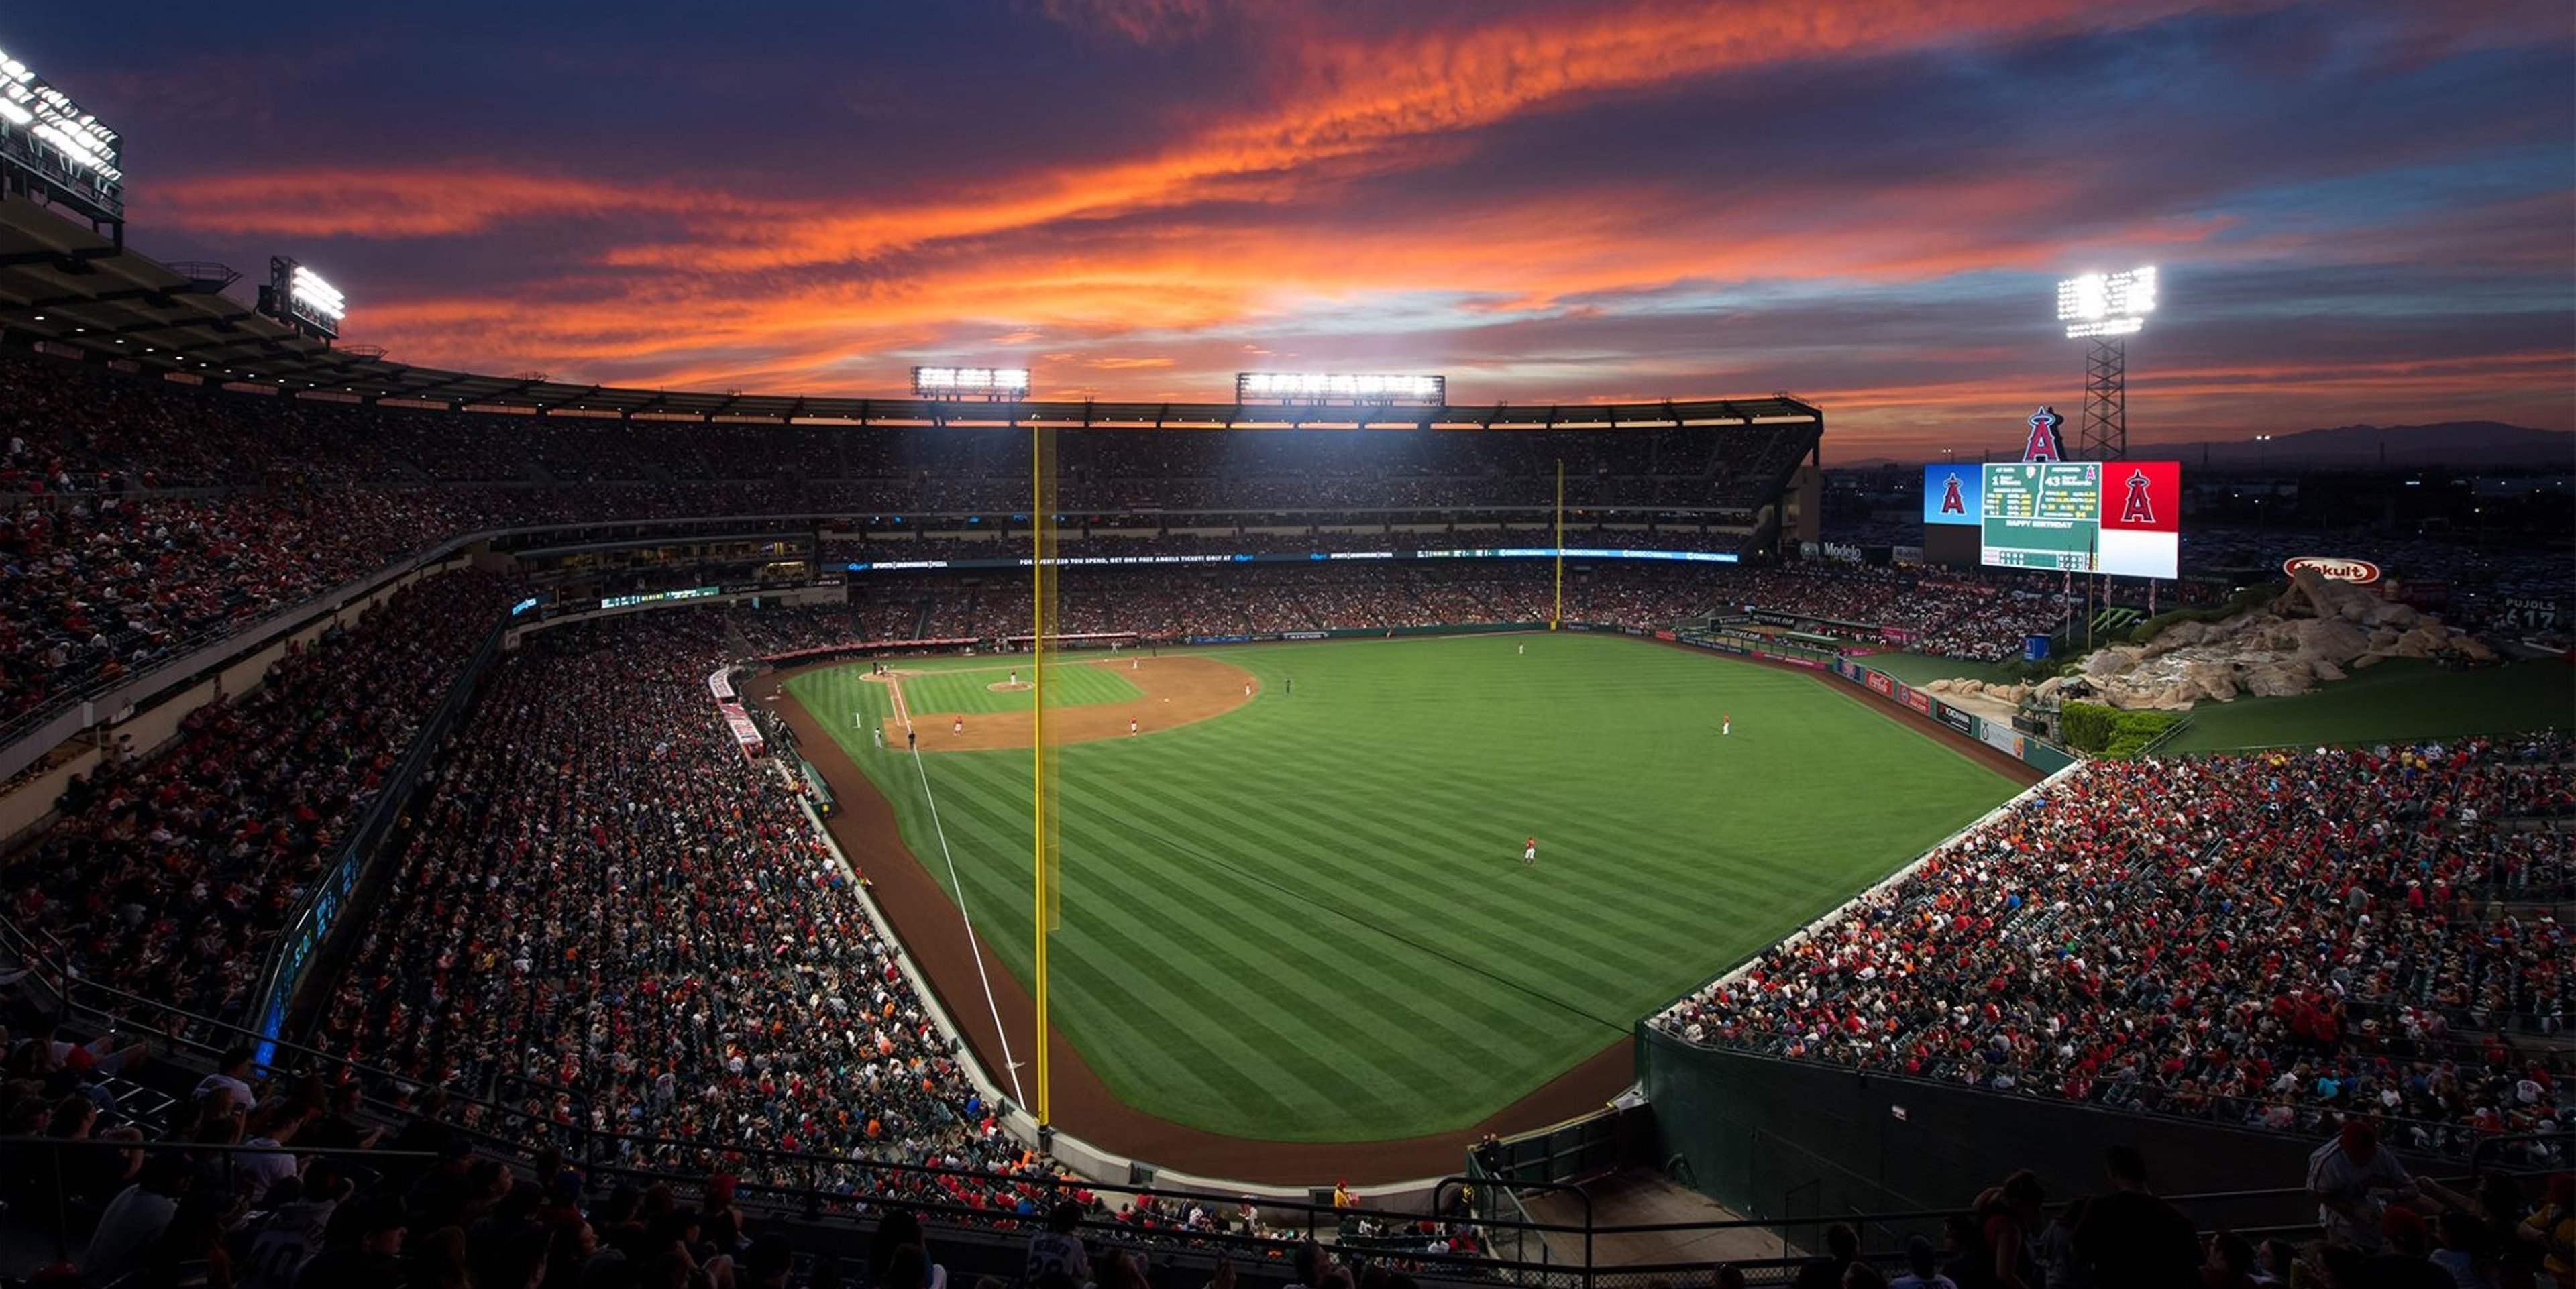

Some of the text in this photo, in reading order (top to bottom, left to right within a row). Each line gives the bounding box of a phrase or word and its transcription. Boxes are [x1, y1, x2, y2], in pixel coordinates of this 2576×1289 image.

[2045, 476, 2060, 486] 43
[1941, 472, 1968, 515] A
[2120, 469, 2156, 523] A
[2033, 520, 2073, 528] BIRTHDAY
[1824, 542, 1862, 559] Modelo
[2506, 598, 2555, 610] PUJOLS
